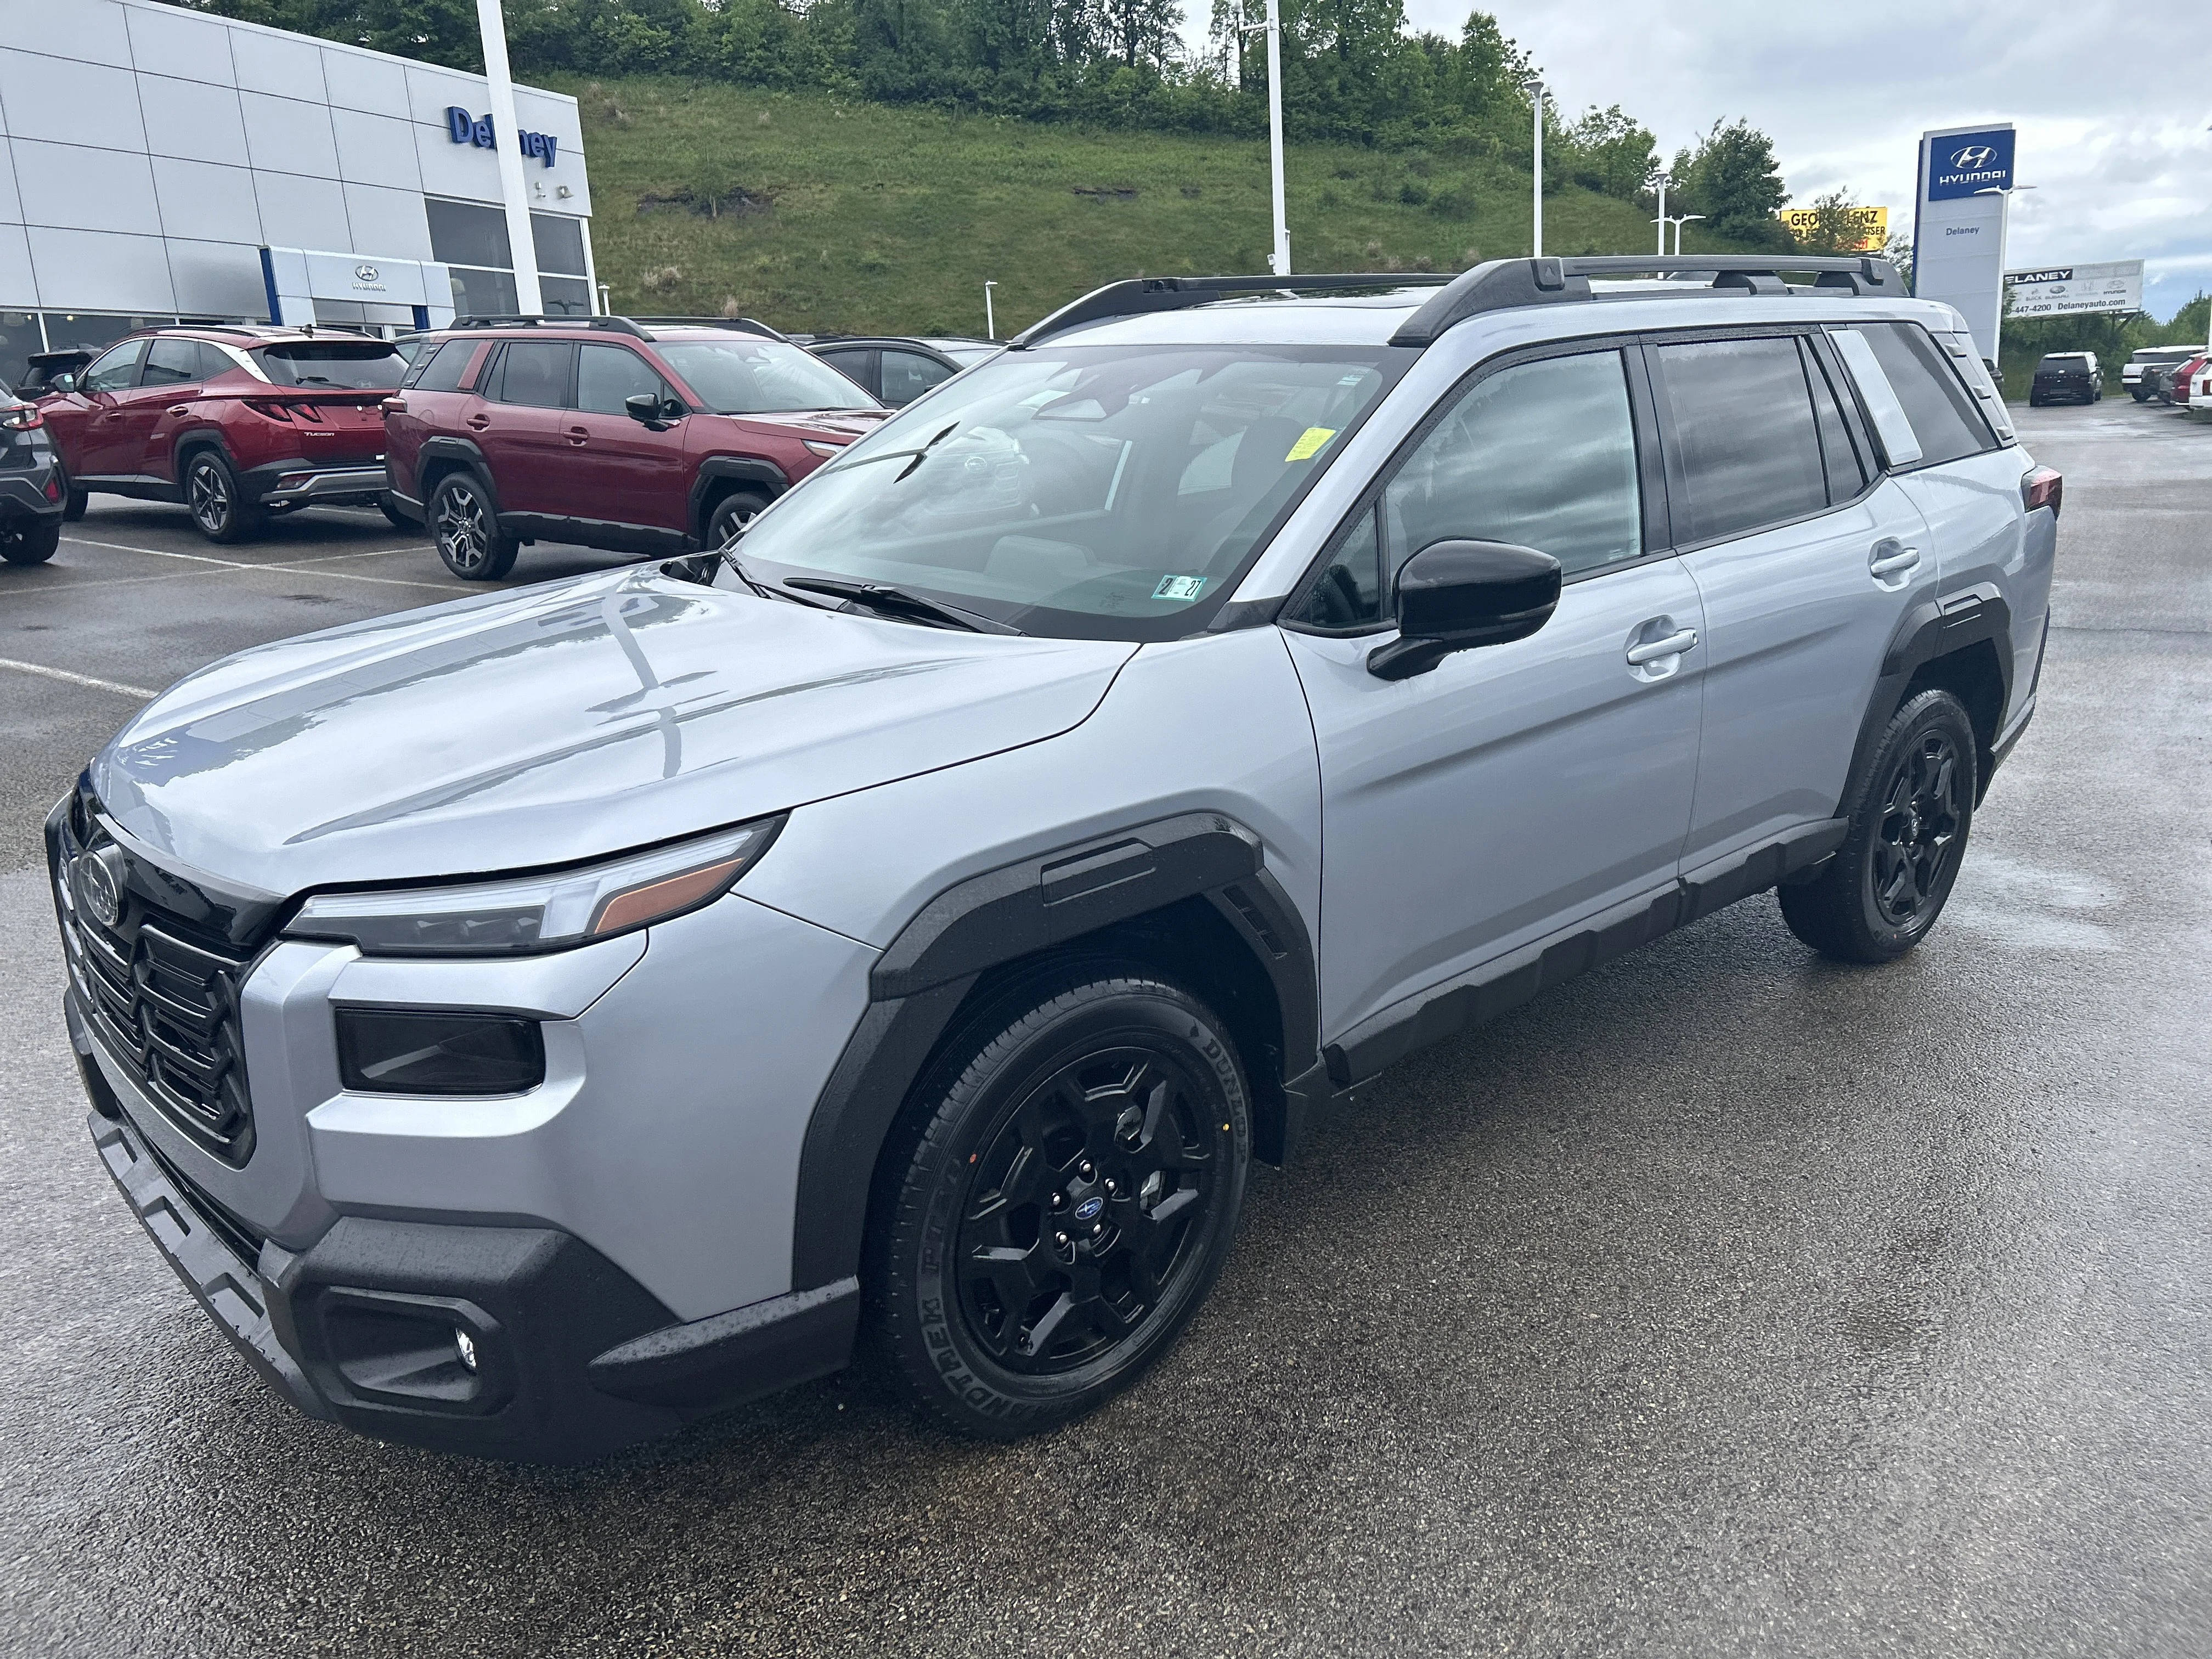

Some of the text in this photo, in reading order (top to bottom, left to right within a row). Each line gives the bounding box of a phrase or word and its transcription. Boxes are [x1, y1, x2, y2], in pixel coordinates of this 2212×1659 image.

[447, 106, 557, 167] Delney
[1939, 170, 2006, 184] HYUNDAI
[1946, 227, 1980, 235] Delaney
[2005, 270, 2070, 283] ELANEY
[352, 282, 386, 292] HYUNDAI
[2010, 299, 2126, 313] -447-4200 Delaneyauto.com
[1184, 580, 1201, 597] 27
[1203, 1037, 1248, 1164] DUNLOP
